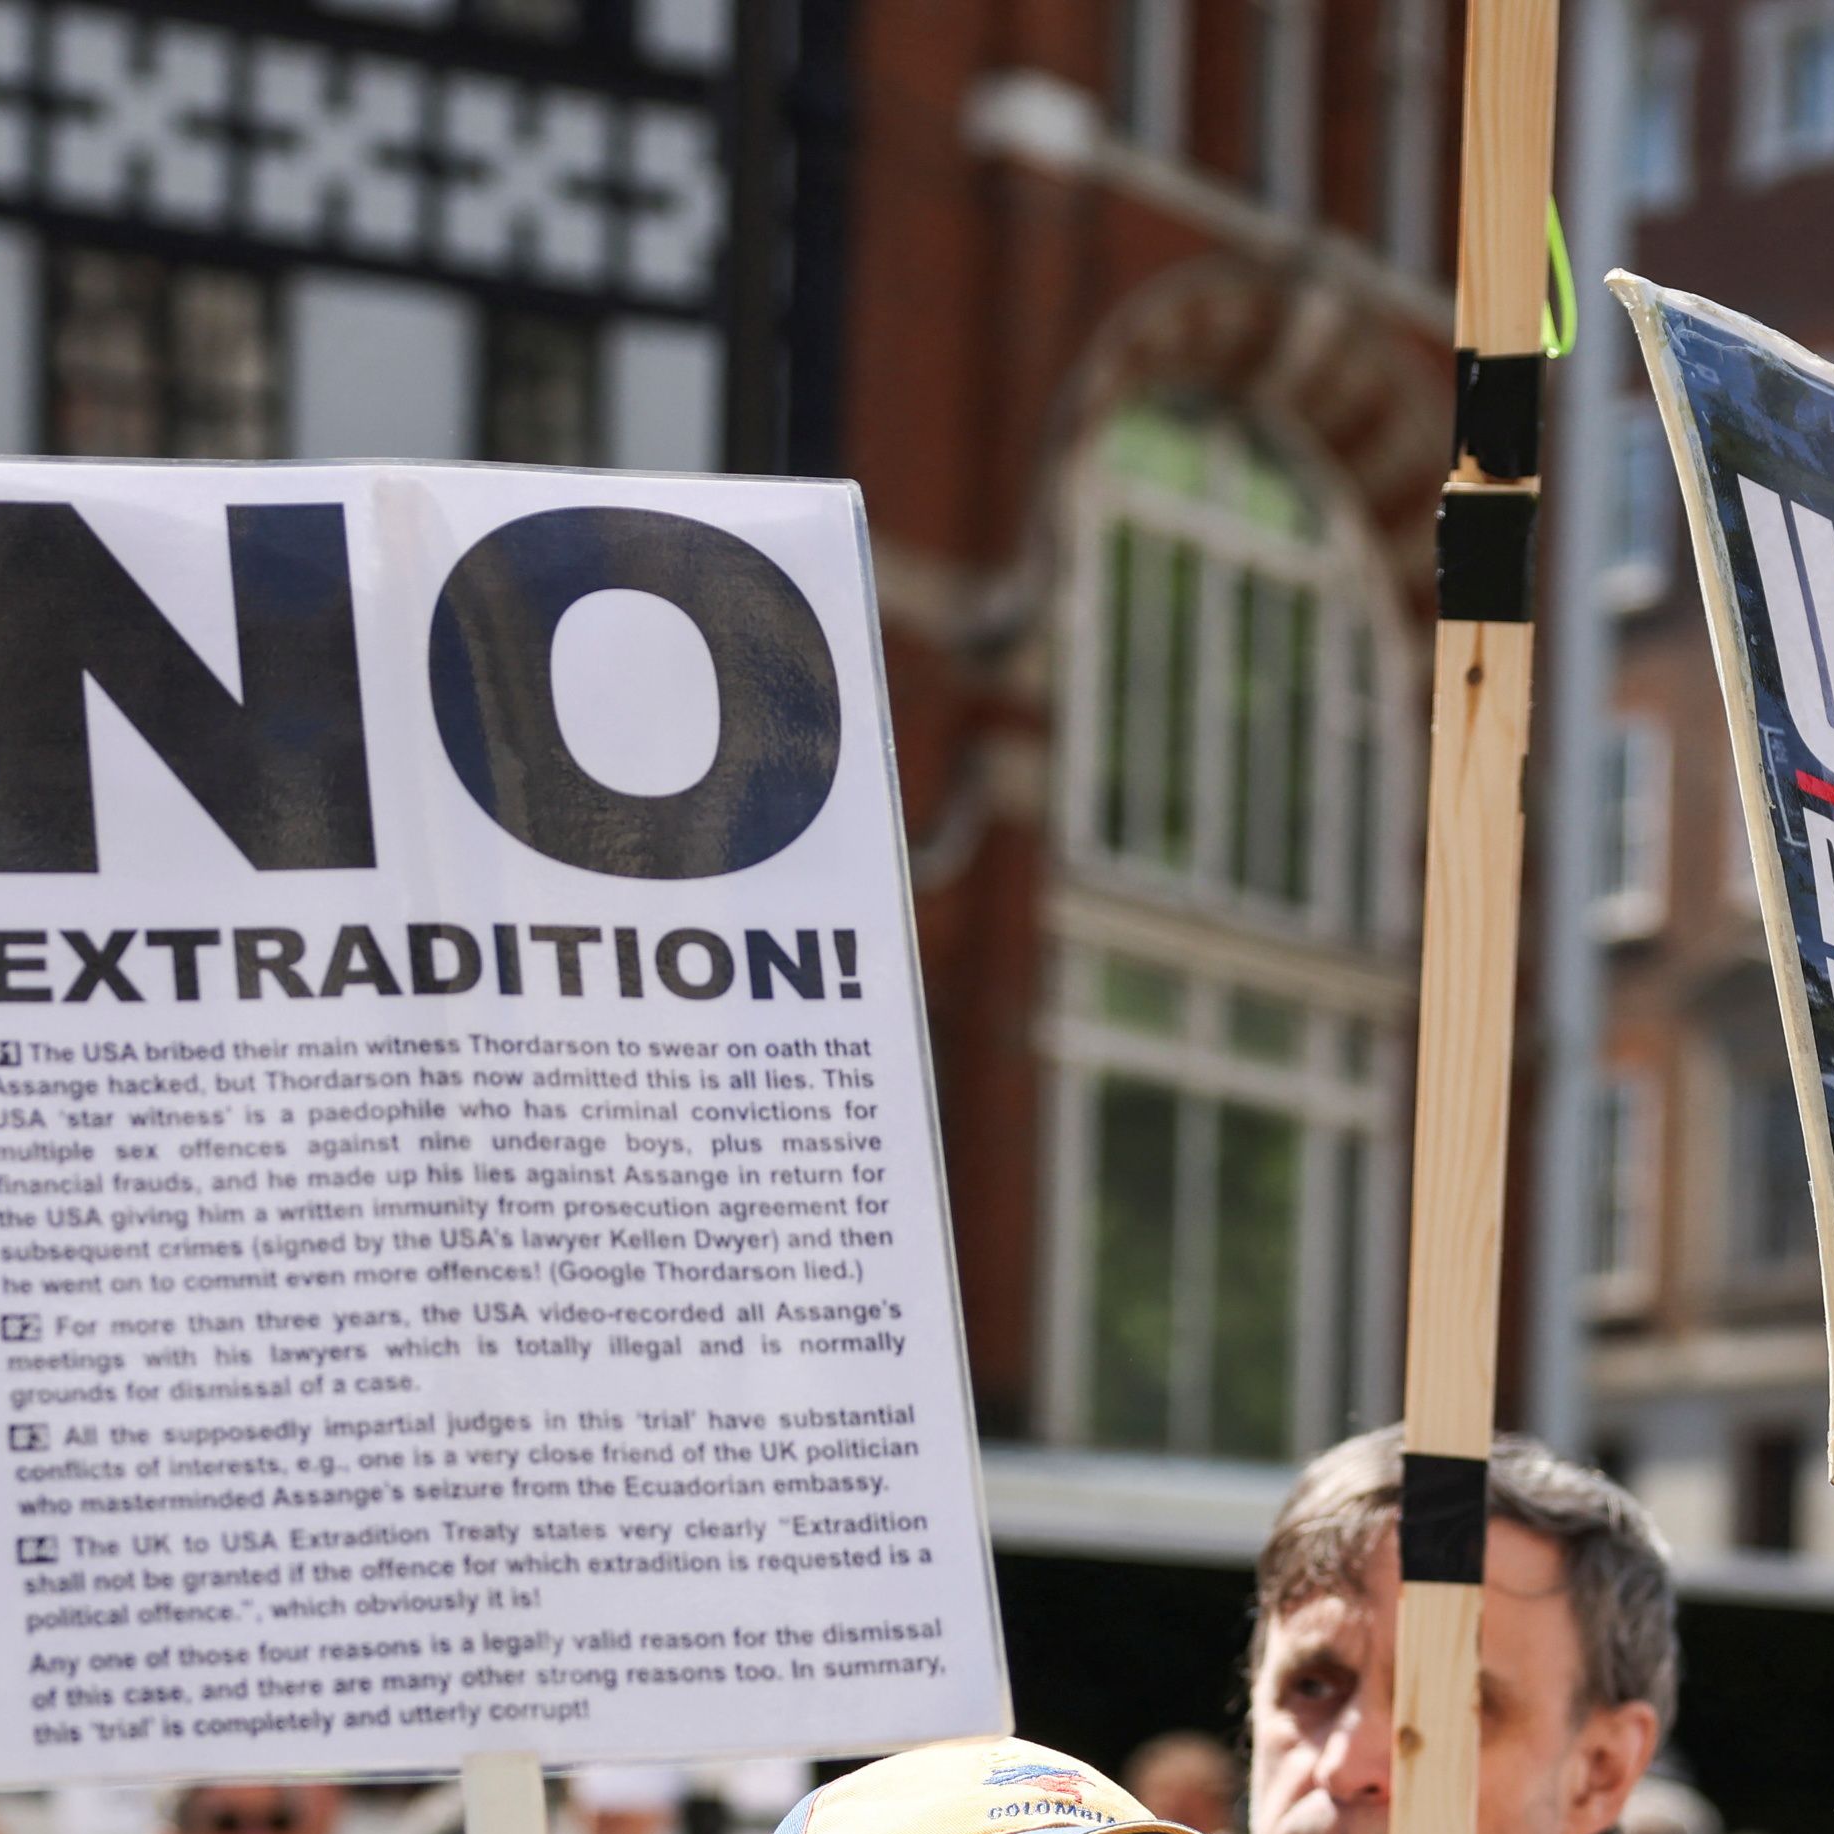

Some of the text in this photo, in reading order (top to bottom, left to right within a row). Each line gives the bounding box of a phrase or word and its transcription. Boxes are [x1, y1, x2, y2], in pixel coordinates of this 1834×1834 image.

[26, 1042, 76, 1064] The
[81, 1040, 140, 1064] USA
[143, 1041, 227, 1063] bribed
[231, 1040, 290, 1061] their
[295, 1040, 360, 1059] main
[364, 1037, 462, 1057] witness
[466, 1032, 611, 1057] Thordarson
[615, 1038, 642, 1058] to
[647, 1040, 720, 1058] swear
[725, 1041, 759, 1059] on
[763, 1037, 819, 1059] oath
[822, 1037, 873, 1059] that
[213, 1073, 257, 1094] but
[263, 1070, 412, 1092] Thordarson
[417, 1066, 465, 1087] has
[471, 1069, 525, 1088] now
[531, 1068, 639, 1089] admitted
[645, 1068, 692, 1090] this
[698, 1072, 722, 1090] is
[728, 1068, 758, 1091] all
[820, 1067, 876, 1090] This
[113, 1144, 160, 1161] sex
[177, 1137, 289, 1160] offences
[306, 1133, 401, 1161] against
[417, 1131, 473, 1152] nine
[490, 1131, 608, 1158] underage
[710, 1133, 764, 1159] plus
[780, 1134, 884, 1154] massive
[0, 1258, 865, 1296] he went on to commit even more offences! (Google Thordarson lied.)
[27, 1617, 944, 1680] Any one of those four reasons is a legally valid reason for the dismissal
[31, 1723, 84, 1746] this
[161, 1720, 186, 1739] is
[191, 1709, 336, 1738] completely
[341, 1706, 393, 1730] and
[397, 1702, 483, 1728] utterly
[487, 1698, 591, 1724] corrupt!
